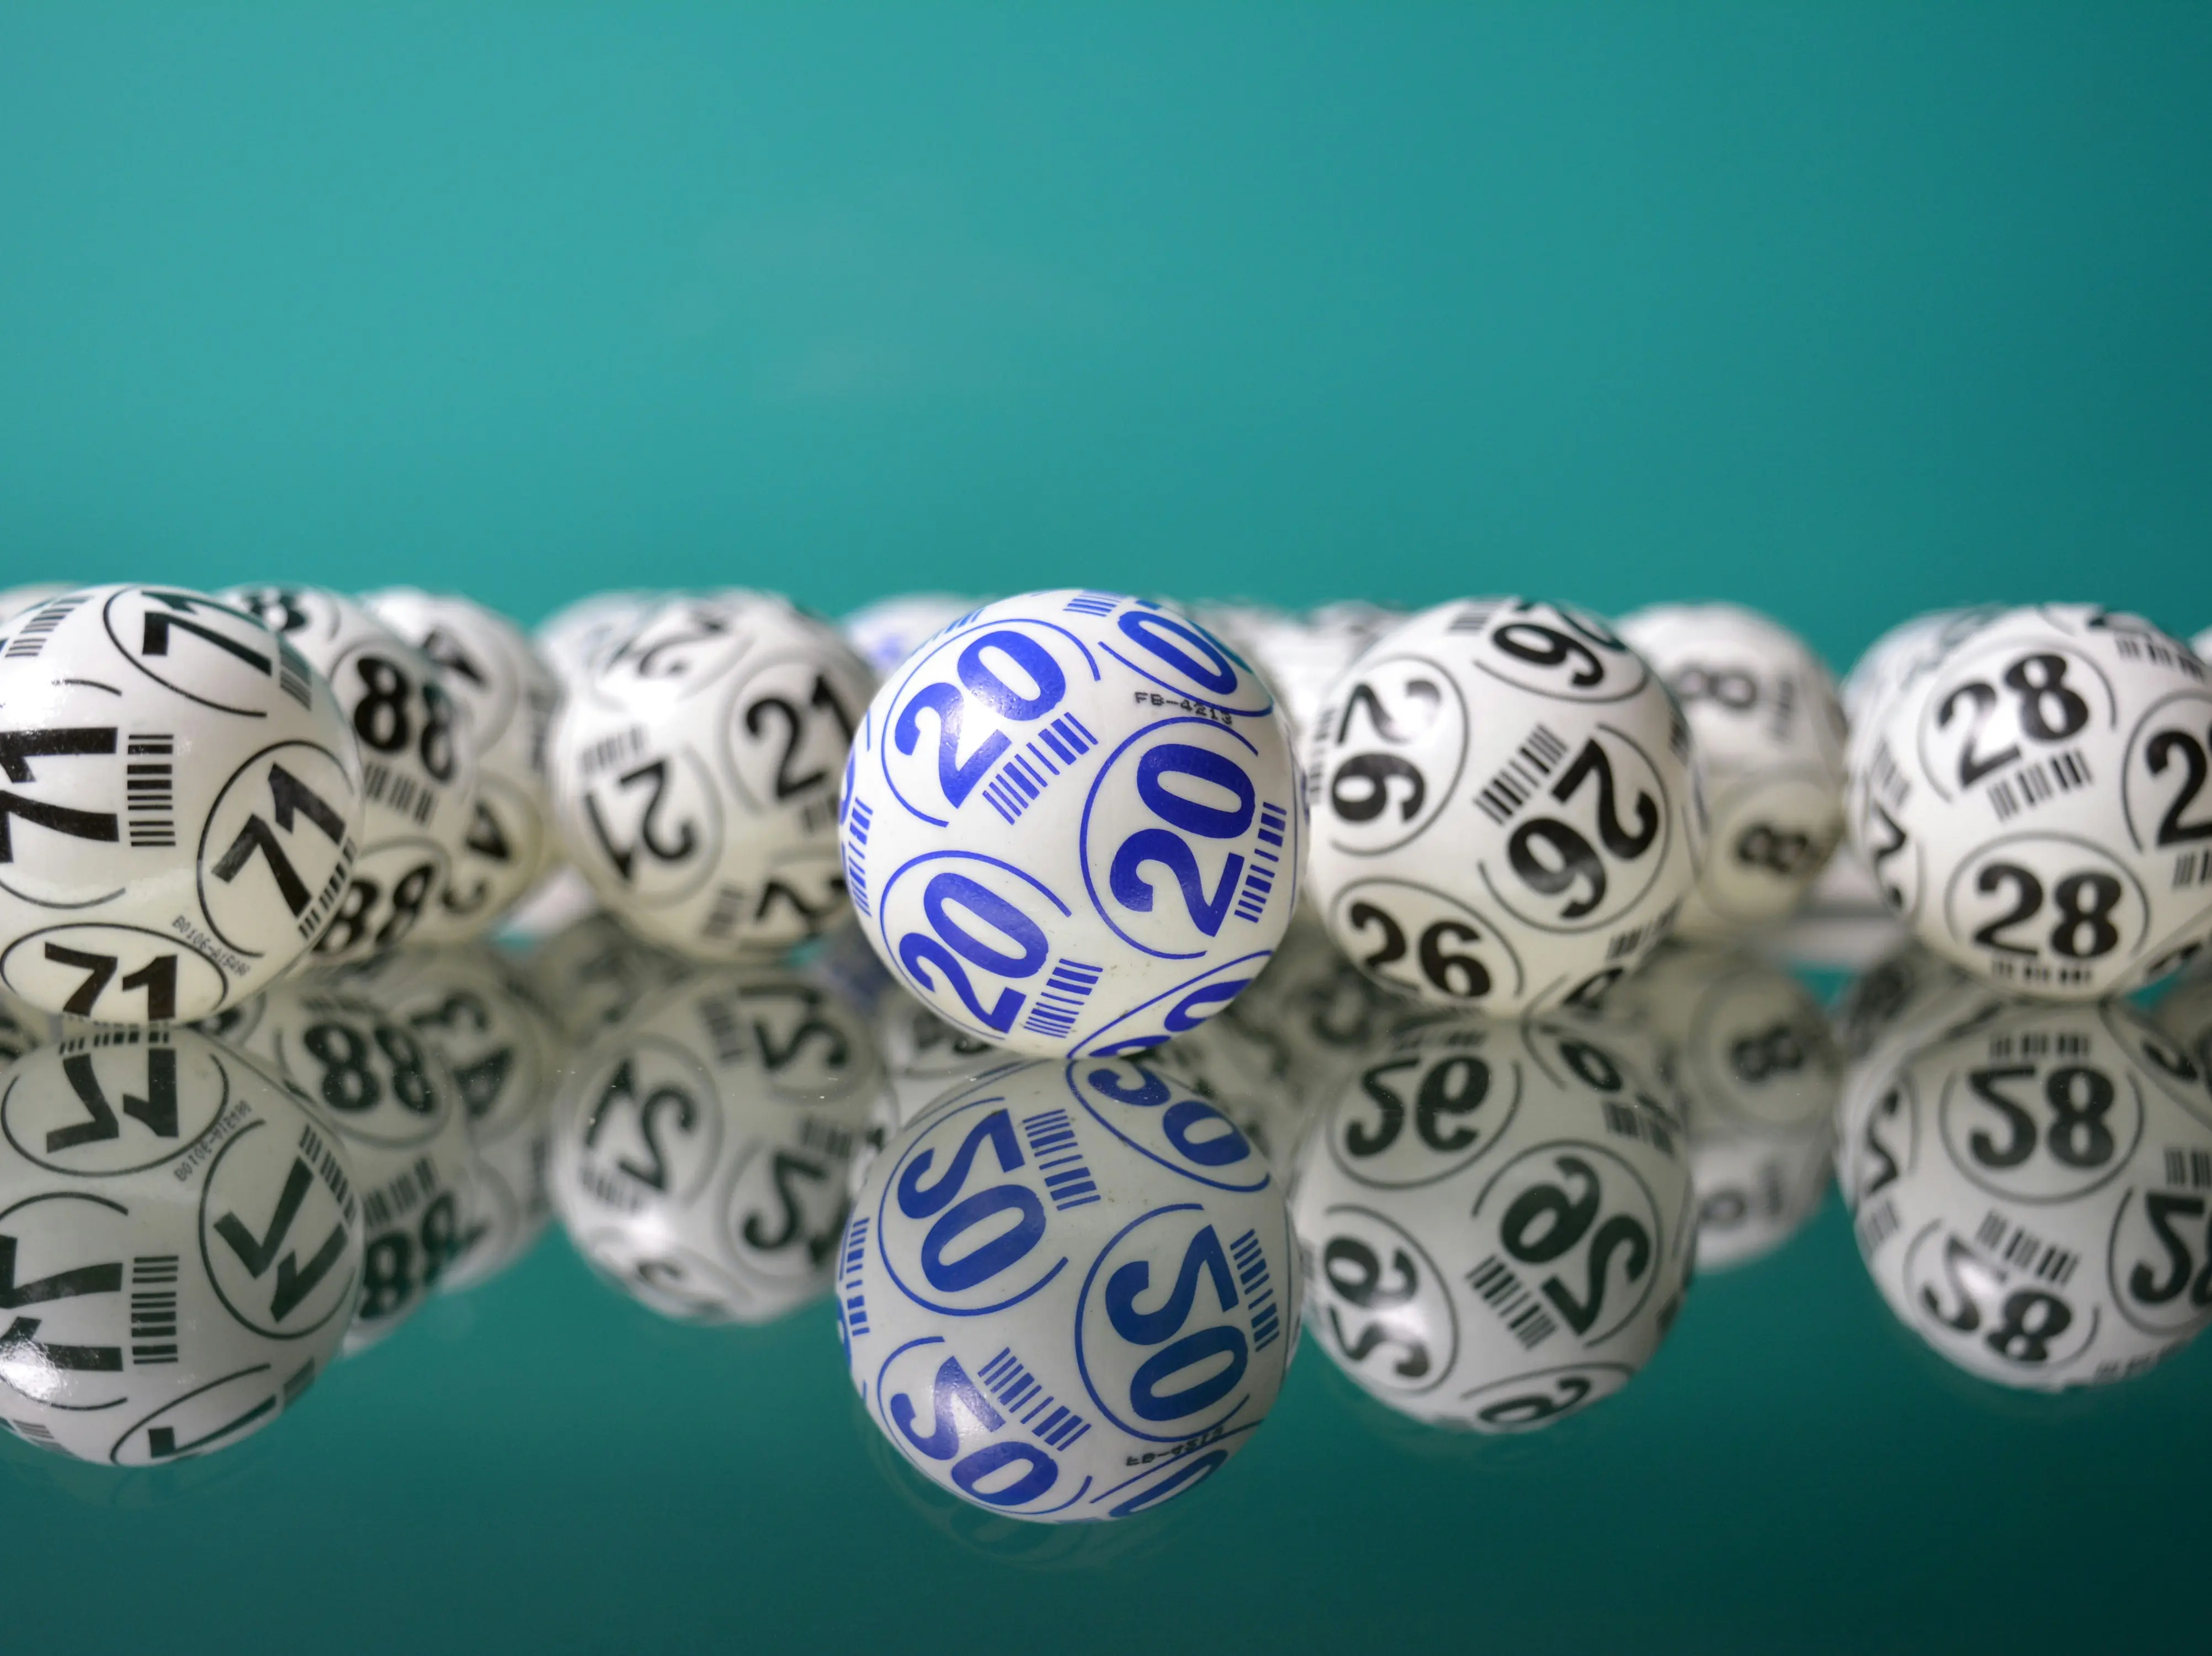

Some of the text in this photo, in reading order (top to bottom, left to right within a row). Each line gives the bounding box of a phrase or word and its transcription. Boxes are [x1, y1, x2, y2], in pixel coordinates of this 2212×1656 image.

[354, 657, 455, 782] 88
[745, 672, 855, 799] 21
[895, 630, 1067, 809] 20
[1330, 678, 1442, 824] 26
[1936, 653, 2089, 789] 28
[2145, 719, 2212, 847] 2
[212, 762, 347, 918] 71
[584, 758, 698, 882] 21
[1110, 744, 1256, 937] 20
[1507, 738, 1658, 920] 26
[899, 872, 1049, 1034] 20
[1349, 900, 1492, 999] 26
[1973, 862, 2123, 959] 28
[45, 942, 178, 1021] 71
